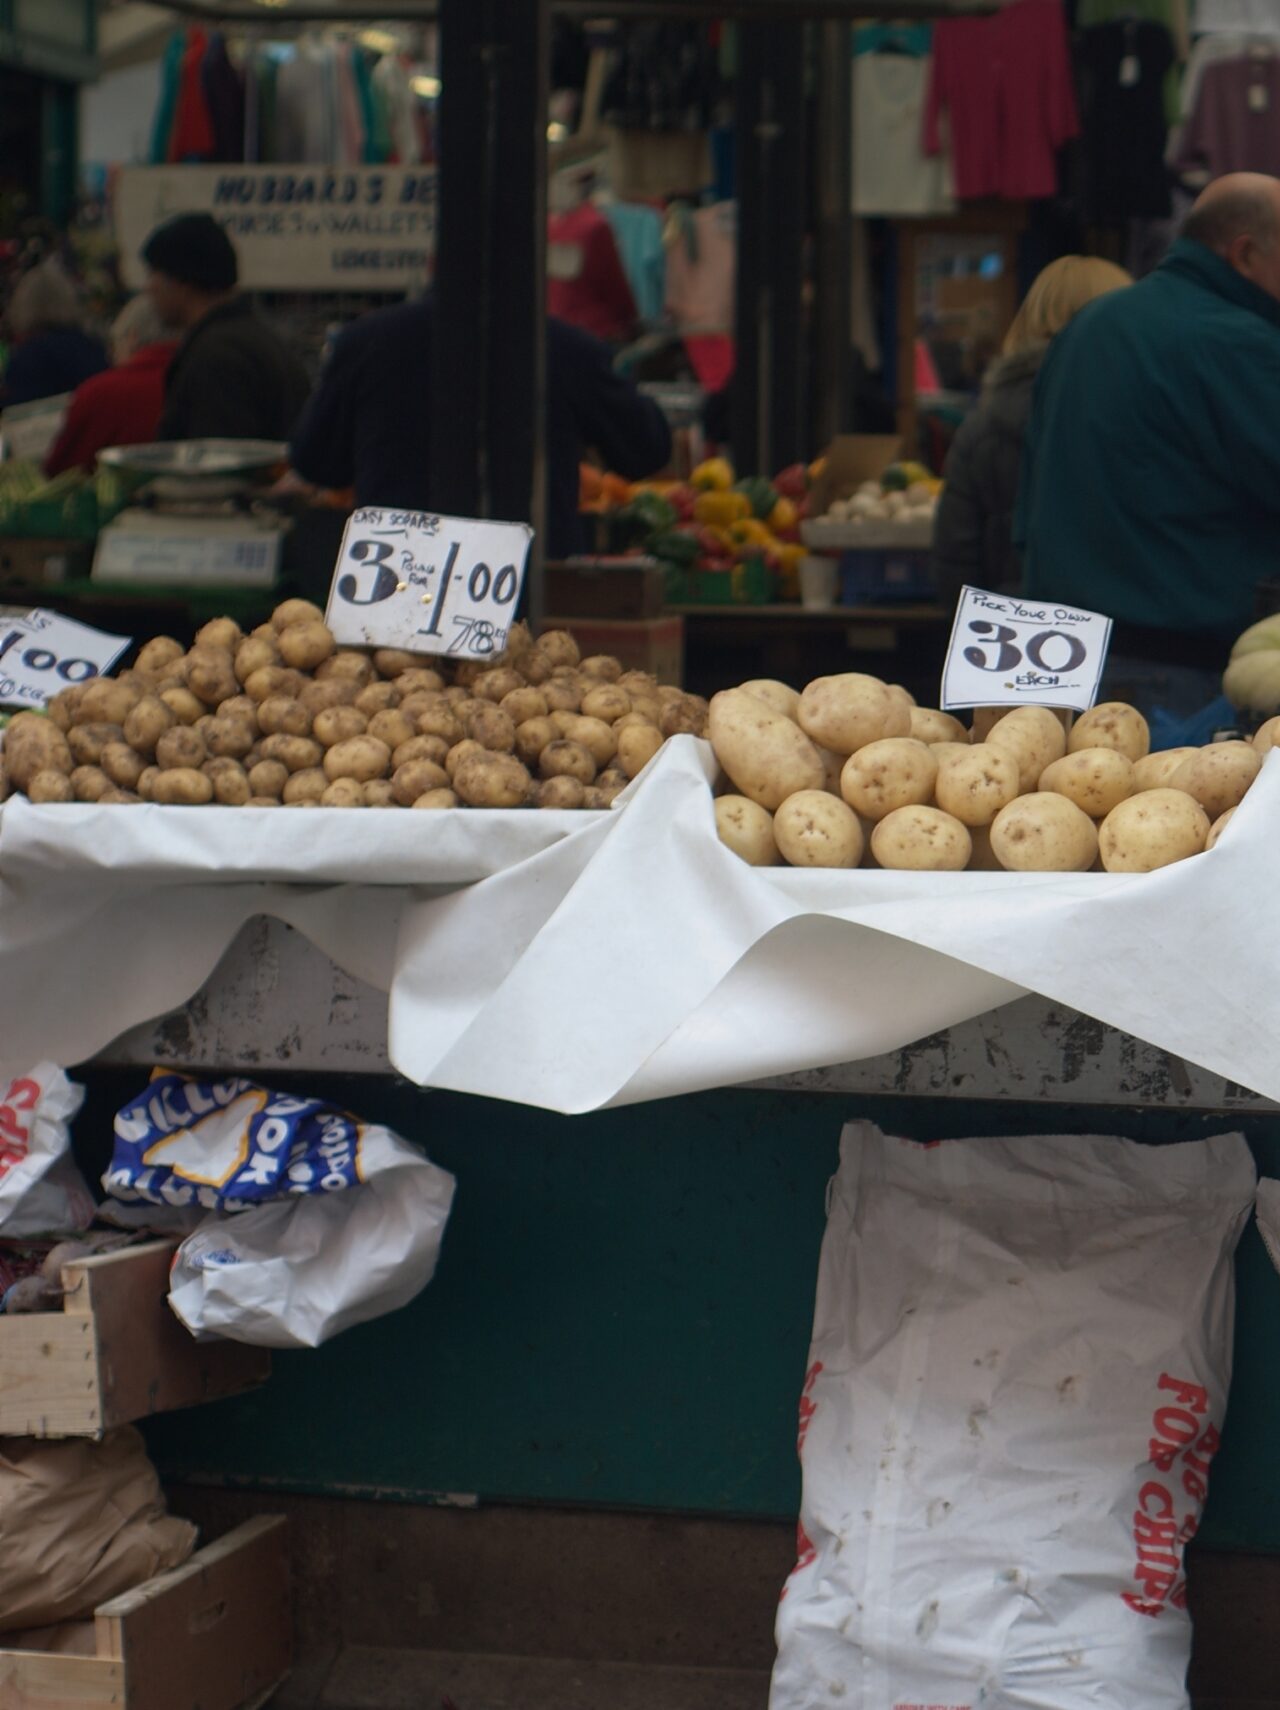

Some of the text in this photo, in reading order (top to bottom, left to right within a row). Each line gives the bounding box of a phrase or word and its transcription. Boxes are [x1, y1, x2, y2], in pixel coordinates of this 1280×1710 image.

[338, 540, 399, 606] 3
[963, 620, 1087, 673] 30
[1015, 675, 1061, 686] EACH
[1149, 1372, 1208, 1473] FOR
